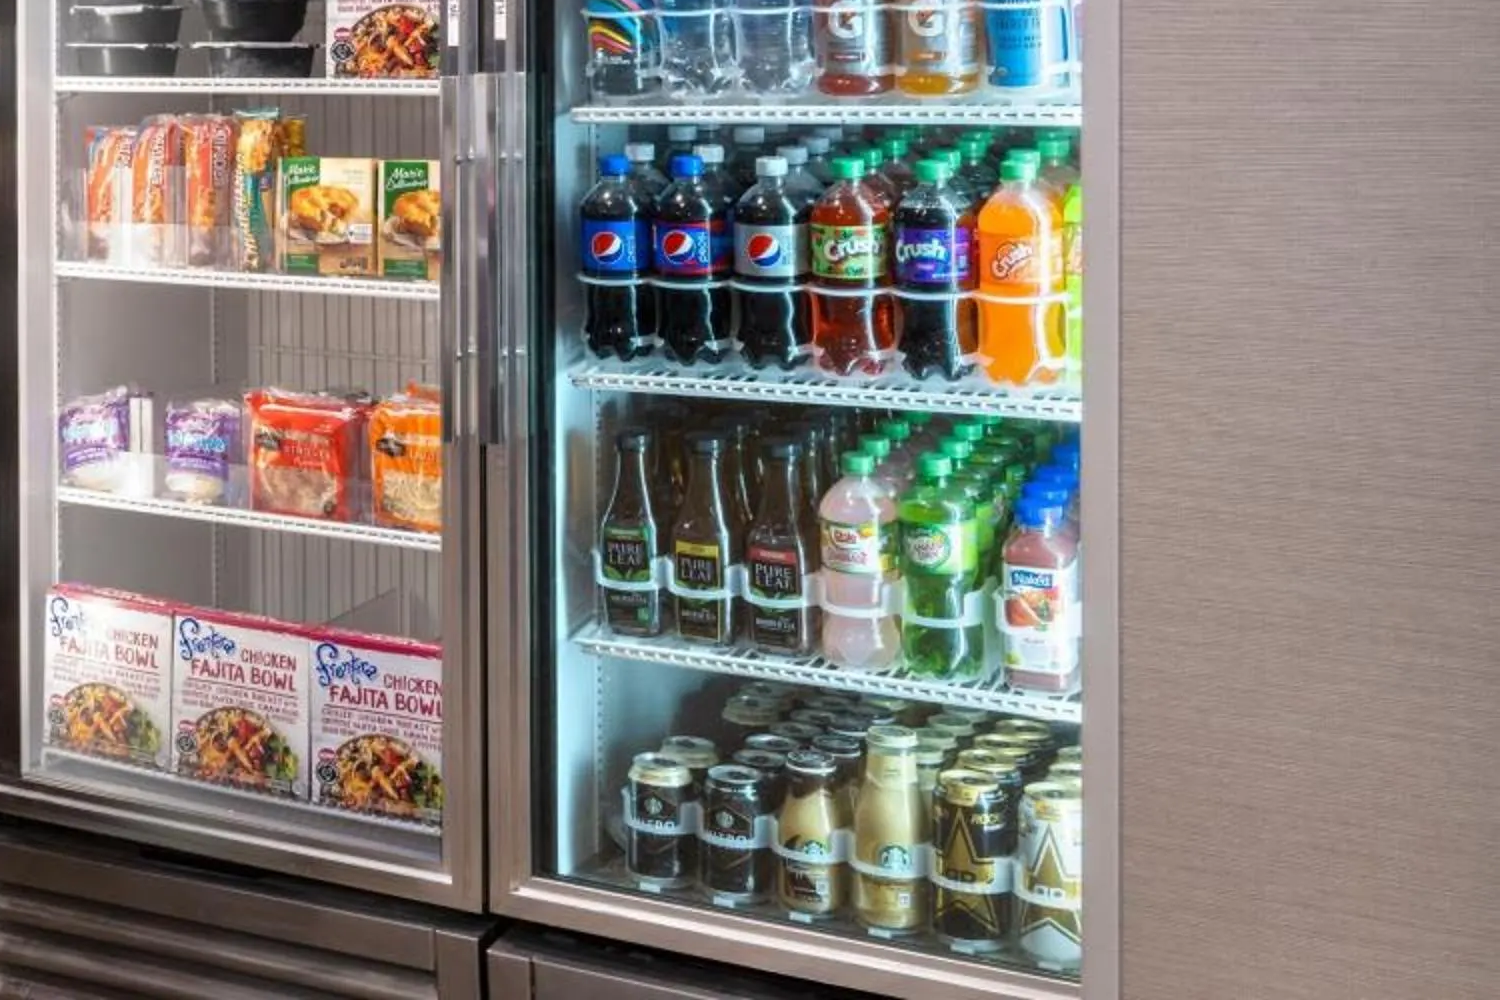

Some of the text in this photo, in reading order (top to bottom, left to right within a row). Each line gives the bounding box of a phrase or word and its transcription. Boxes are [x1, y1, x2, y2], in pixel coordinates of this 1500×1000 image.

[824, 238, 880, 263] Crush
[896, 238, 946, 263] Crush
[991, 241, 1034, 279] Crush
[115, 643, 159, 669] BOWL
[240, 648, 297, 673] CHICKEN
[191, 659, 297, 692] FAJITA BOWL
[383, 673, 443, 697] CHICKEN
[328, 685, 389, 710] FAJITA
